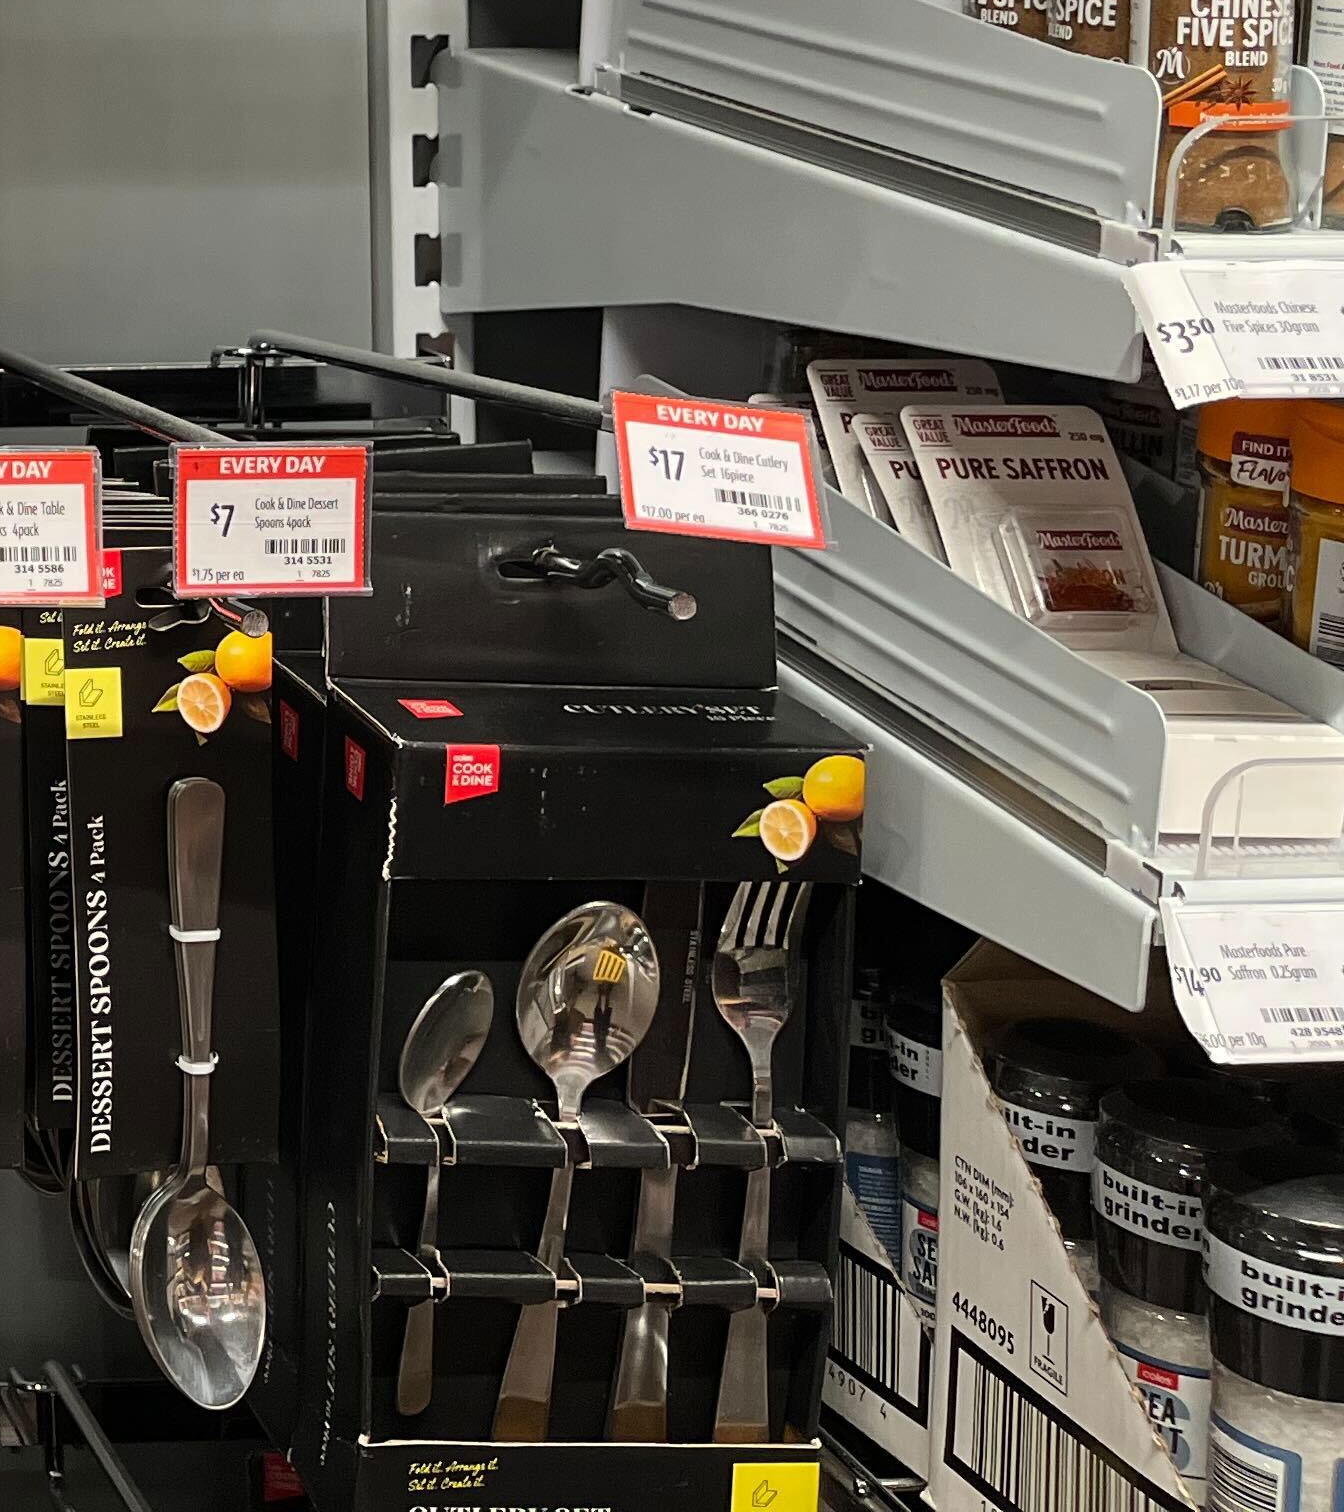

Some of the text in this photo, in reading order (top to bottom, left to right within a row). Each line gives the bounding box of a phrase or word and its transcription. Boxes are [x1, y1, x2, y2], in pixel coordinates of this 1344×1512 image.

[1177, 17, 1237, 49] FIVE
[1224, 50, 1269, 67] BLEND
[656, 405, 764, 433] EVERY DAY
[12, 461, 53, 478] DAY
[219, 456, 326, 474] EVERY DAY
[649, 446, 685, 481] $17
[936, 458, 1110, 481] PURE SAFFRON
[211, 503, 235, 537] $7
[88, 814, 105, 866] Pack
[86, 889, 110, 1015] SPOONS
[89, 1021, 112, 1154] DESSERT
[951, 1290, 1016, 1356] 4448095
[1033, 1354, 1064, 1387] FRAGILE
